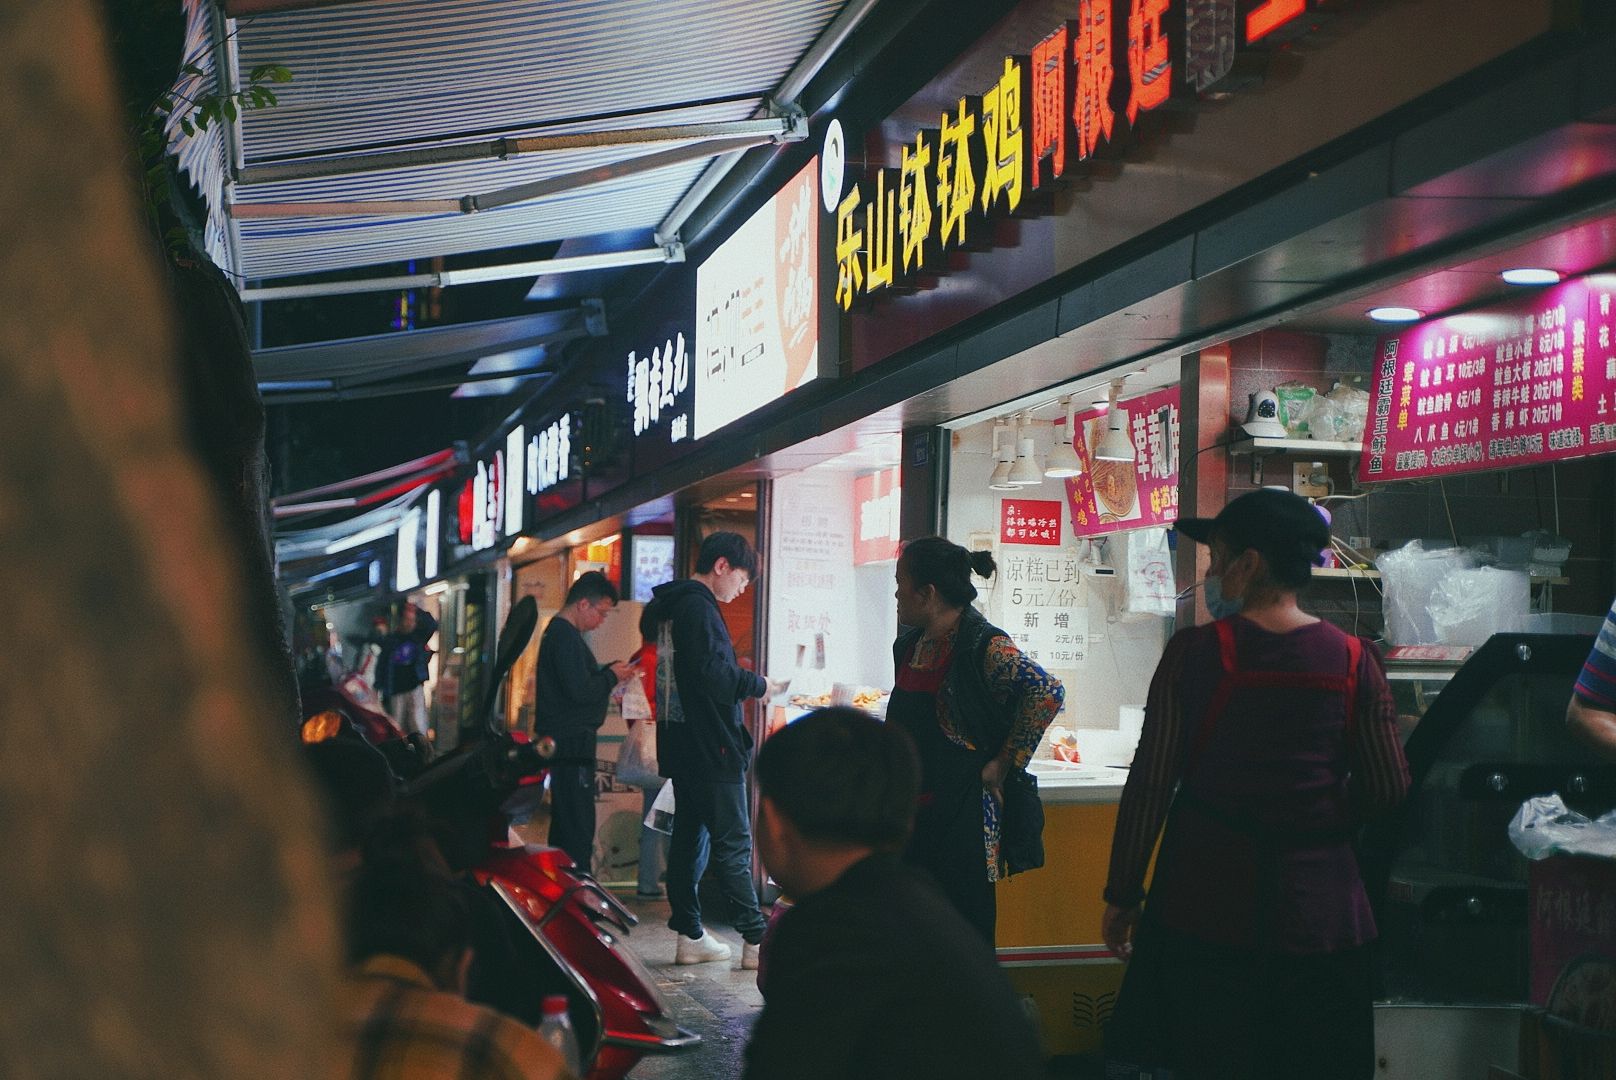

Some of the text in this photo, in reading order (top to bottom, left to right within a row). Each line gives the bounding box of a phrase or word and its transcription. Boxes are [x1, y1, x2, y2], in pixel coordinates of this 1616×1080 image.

[835, 56, 1023, 311] 乐山钵钵鸡
[1368, 339, 1400, 474] 阿根廷霸王鱿鱼
[1414, 422, 1449, 444] 八爪鱼
[1007, 557, 1080, 585] 凉糕已到
[1012, 587, 1077, 607] 5元/份
[1024, 612, 1070, 629] 新增
[1055, 635, 1084, 644] 2元/份
[1050, 651, 1084, 661] 10元/份
